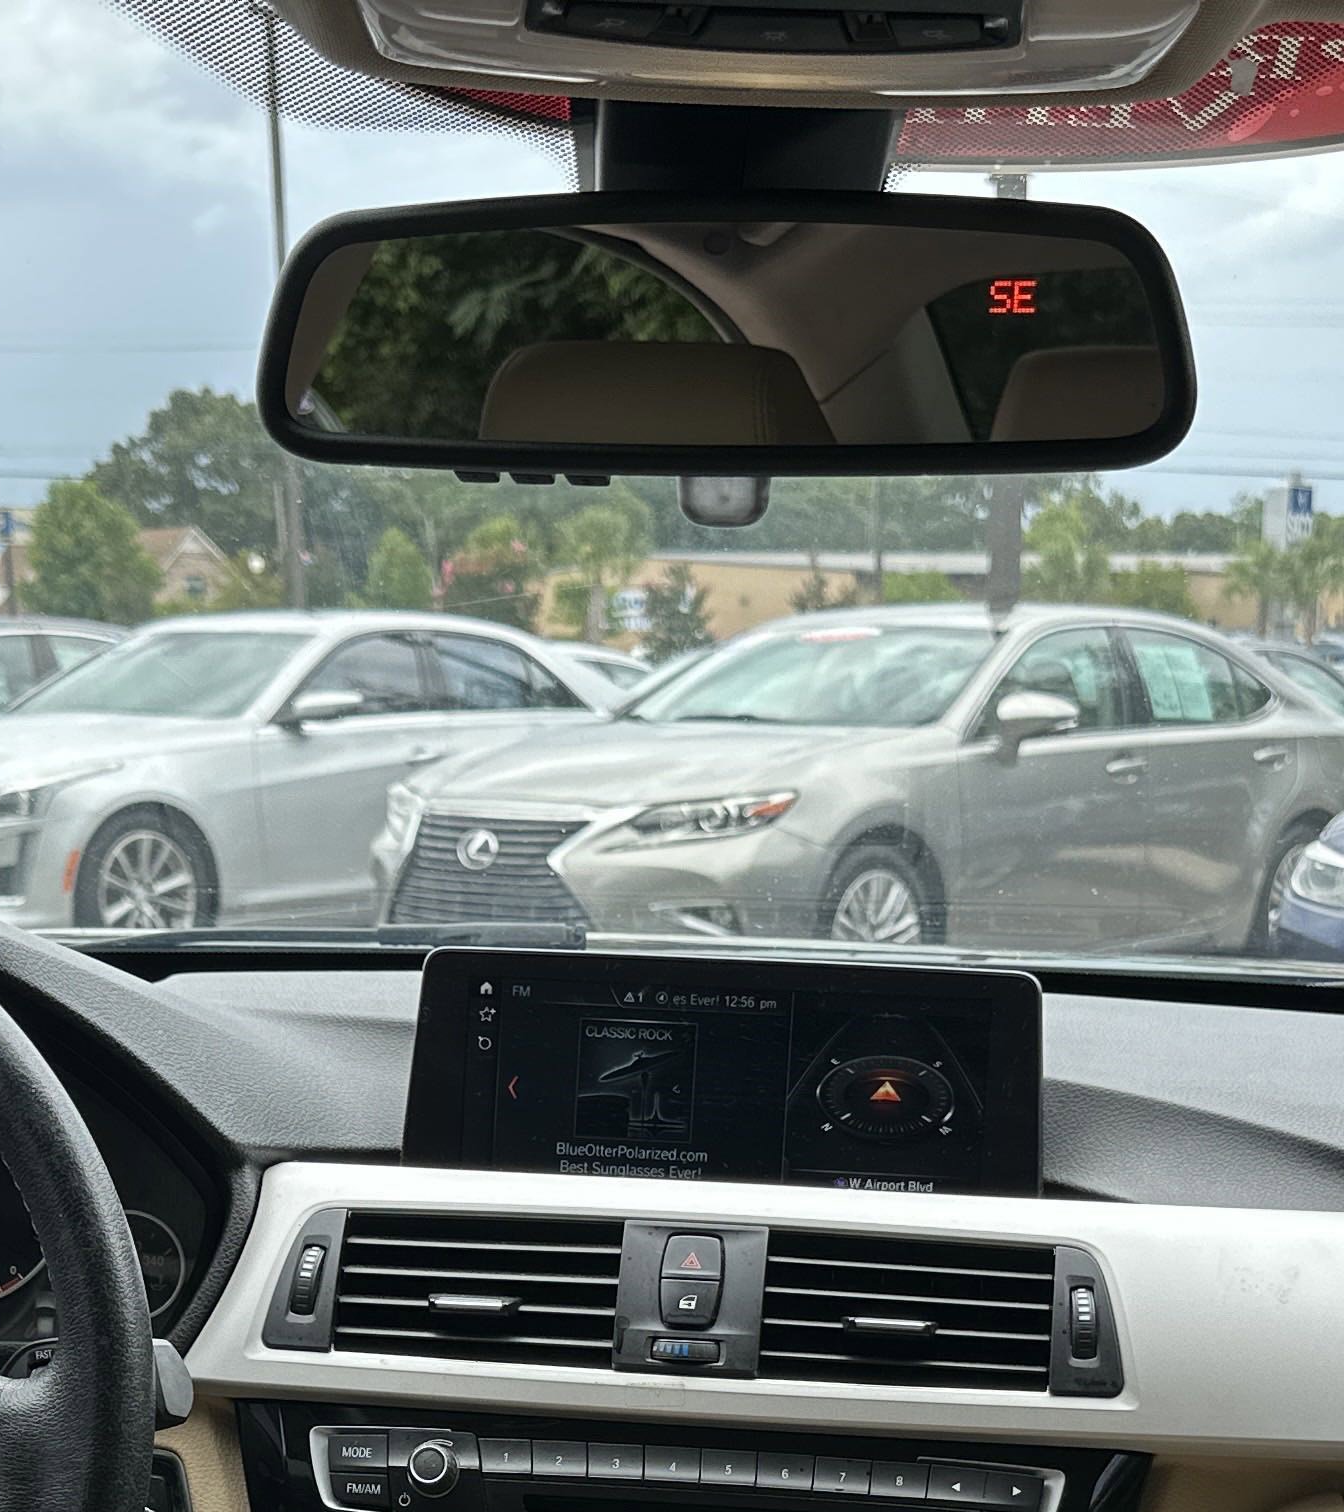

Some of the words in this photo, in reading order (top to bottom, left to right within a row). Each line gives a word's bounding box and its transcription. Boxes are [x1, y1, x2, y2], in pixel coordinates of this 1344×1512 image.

[989, 279, 1037, 314] SE
[512, 985, 531, 997] FM
[725, 996, 755, 1008] 12:56
[760, 999, 777, 1010] pm
[585, 1025, 636, 1040] CLASSIC
[638, 1028, 672, 1041] ROCK
[820, 1122, 833, 1132] N
[556, 1141, 708, 1163] BlueOtterPolarized.com
[559, 1159, 588, 1174] Best
[591, 1161, 665, 1178] Sunglasses
[669, 1166, 702, 1180] Ever!
[849, 1178, 862, 1188] W
[864, 1179, 905, 1191] Airport
[908, 1181, 933, 1192] Blvd
[9, 1266, 17, 1275] 0
[341, 1446, 373, 1459] MODE
[503, 1452, 509, 1463] 1
[555, 1456, 562, 1466] 2
[612, 1458, 620, 1469] 3
[669, 1462, 677, 1472] 4
[724, 1464, 732, 1475] 5
[781, 1468, 789, 1480] 6
[839, 1472, 846, 1483] 7
[895, 1476, 903, 1486] 8
[346, 1482, 381, 1495] FM/AM
